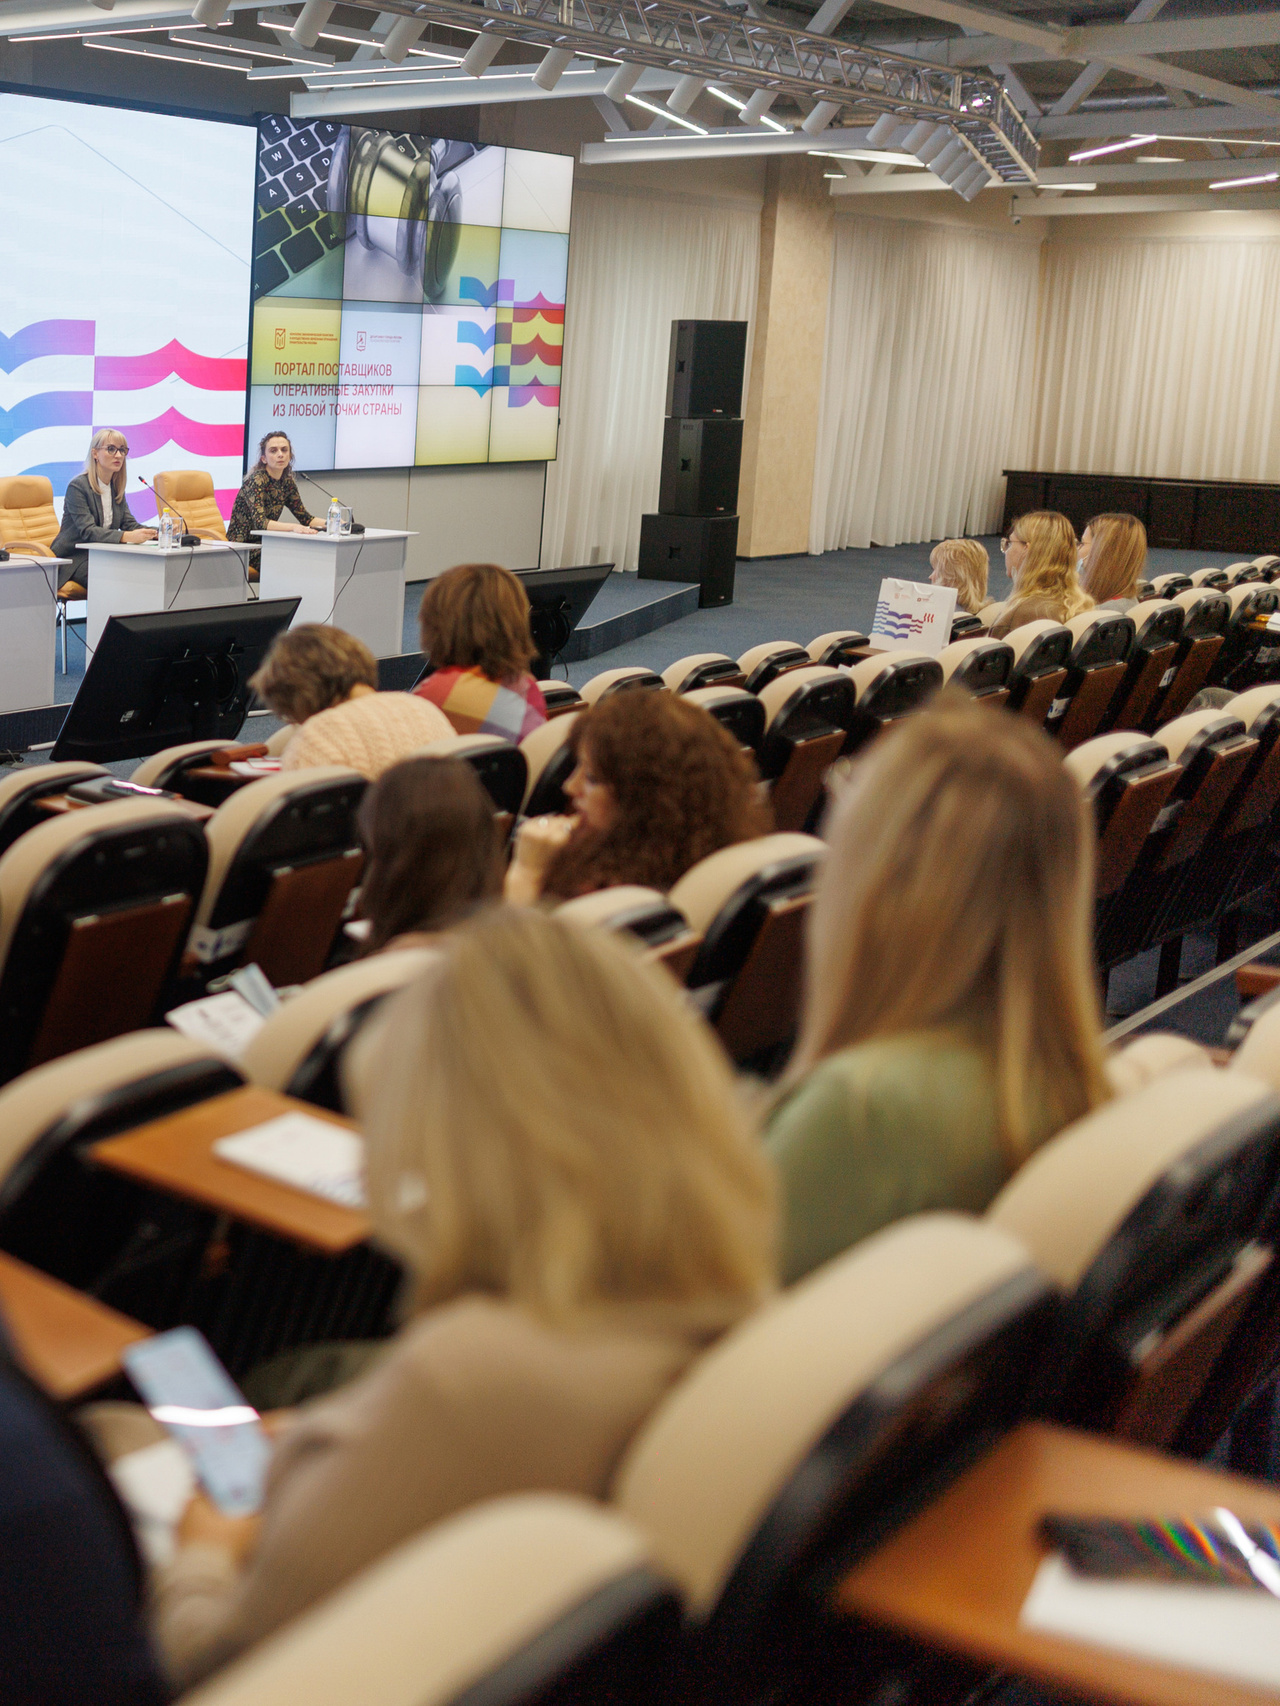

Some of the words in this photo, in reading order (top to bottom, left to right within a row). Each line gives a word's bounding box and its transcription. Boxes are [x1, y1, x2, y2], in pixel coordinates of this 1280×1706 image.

[325, 124, 334, 132] R
[300, 137, 308, 146] E
[271, 151, 282, 161] W
[296, 172, 304, 181] S
[269, 188, 277, 197] A
[274, 362, 315, 376] ПОРТАЛ
[317, 362, 393, 378] ПОСТАВЩИКОВ
[273, 384, 350, 396] ОПЕРАТИВНЫЕ
[352, 384, 394, 396] ЗАКУПКИ
[272, 403, 286, 417] ИЗ
[288, 400, 326, 417] ЛЮБОЙ
[328, 403, 360, 416] ТОЧКИ
[362, 402, 402, 415] СТРАНЫ
